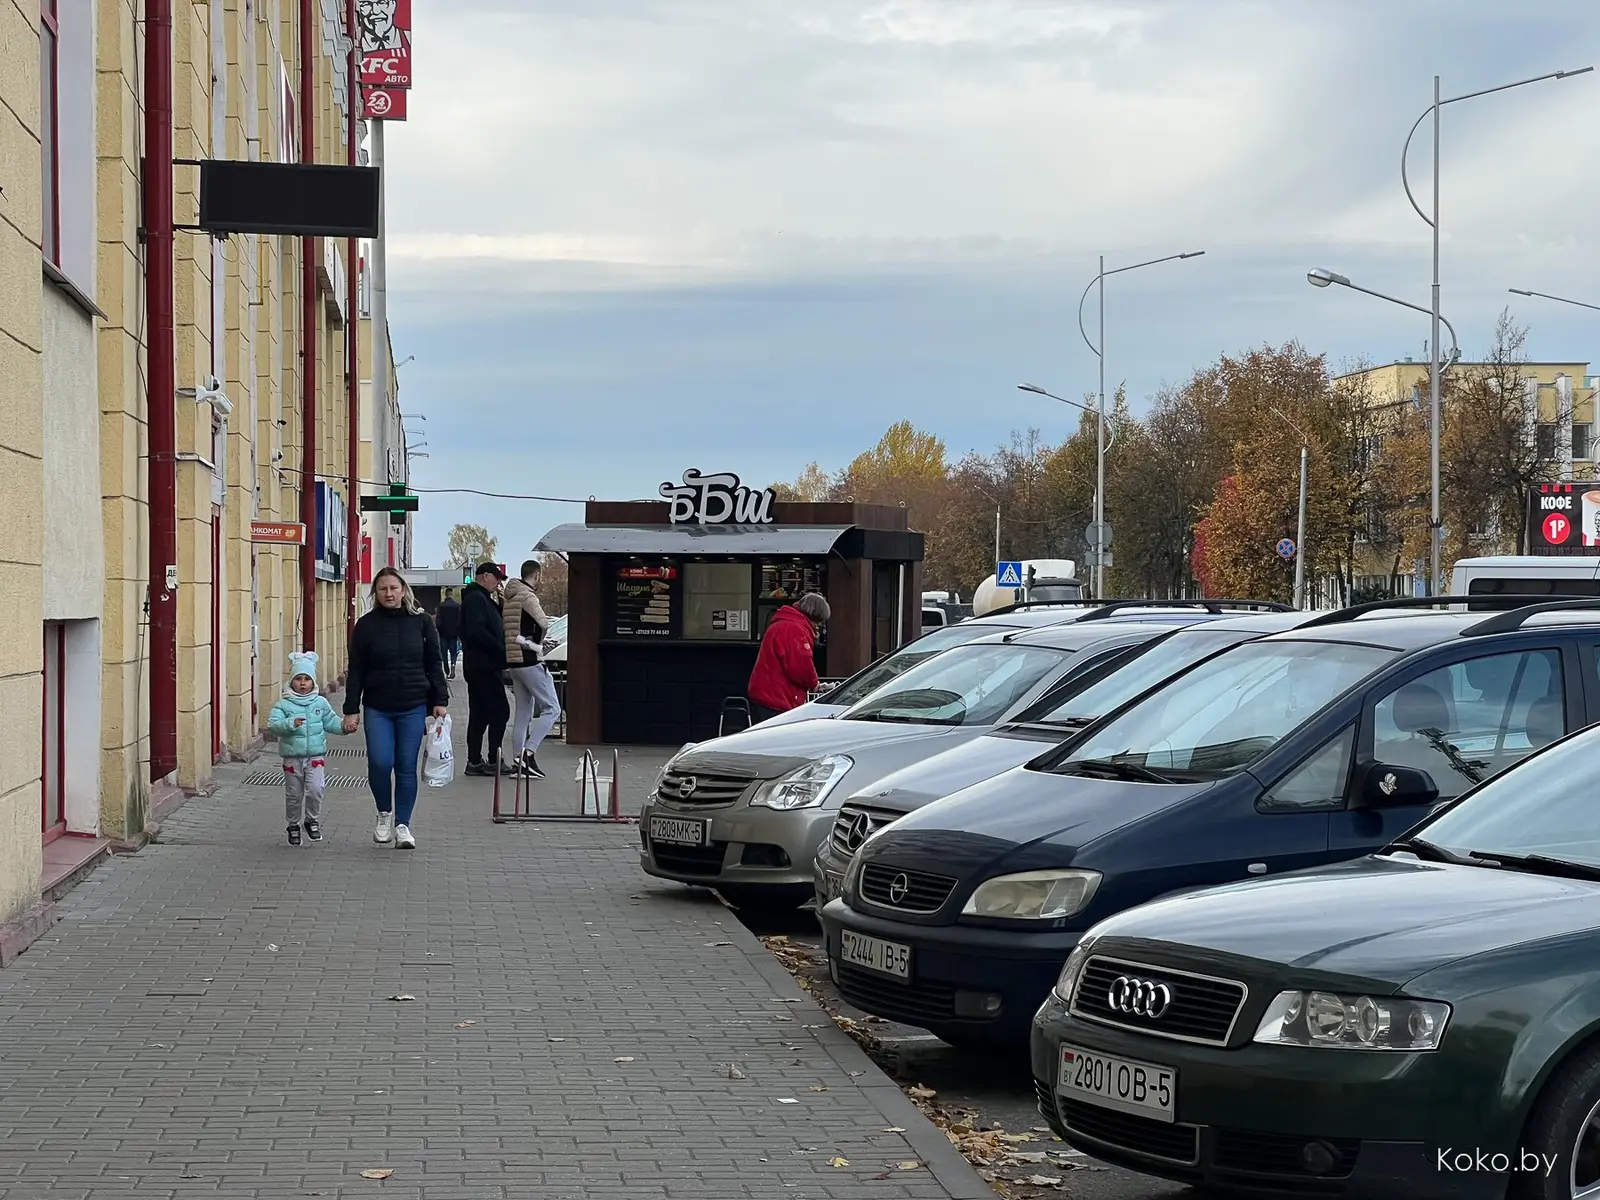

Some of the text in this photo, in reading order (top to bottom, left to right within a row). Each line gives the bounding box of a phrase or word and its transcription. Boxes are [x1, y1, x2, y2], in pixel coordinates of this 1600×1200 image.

[360, 58, 398, 74] KFC
[384, 75, 408, 83] АВТО
[1541, 496, 1572, 509] КОФЕ
